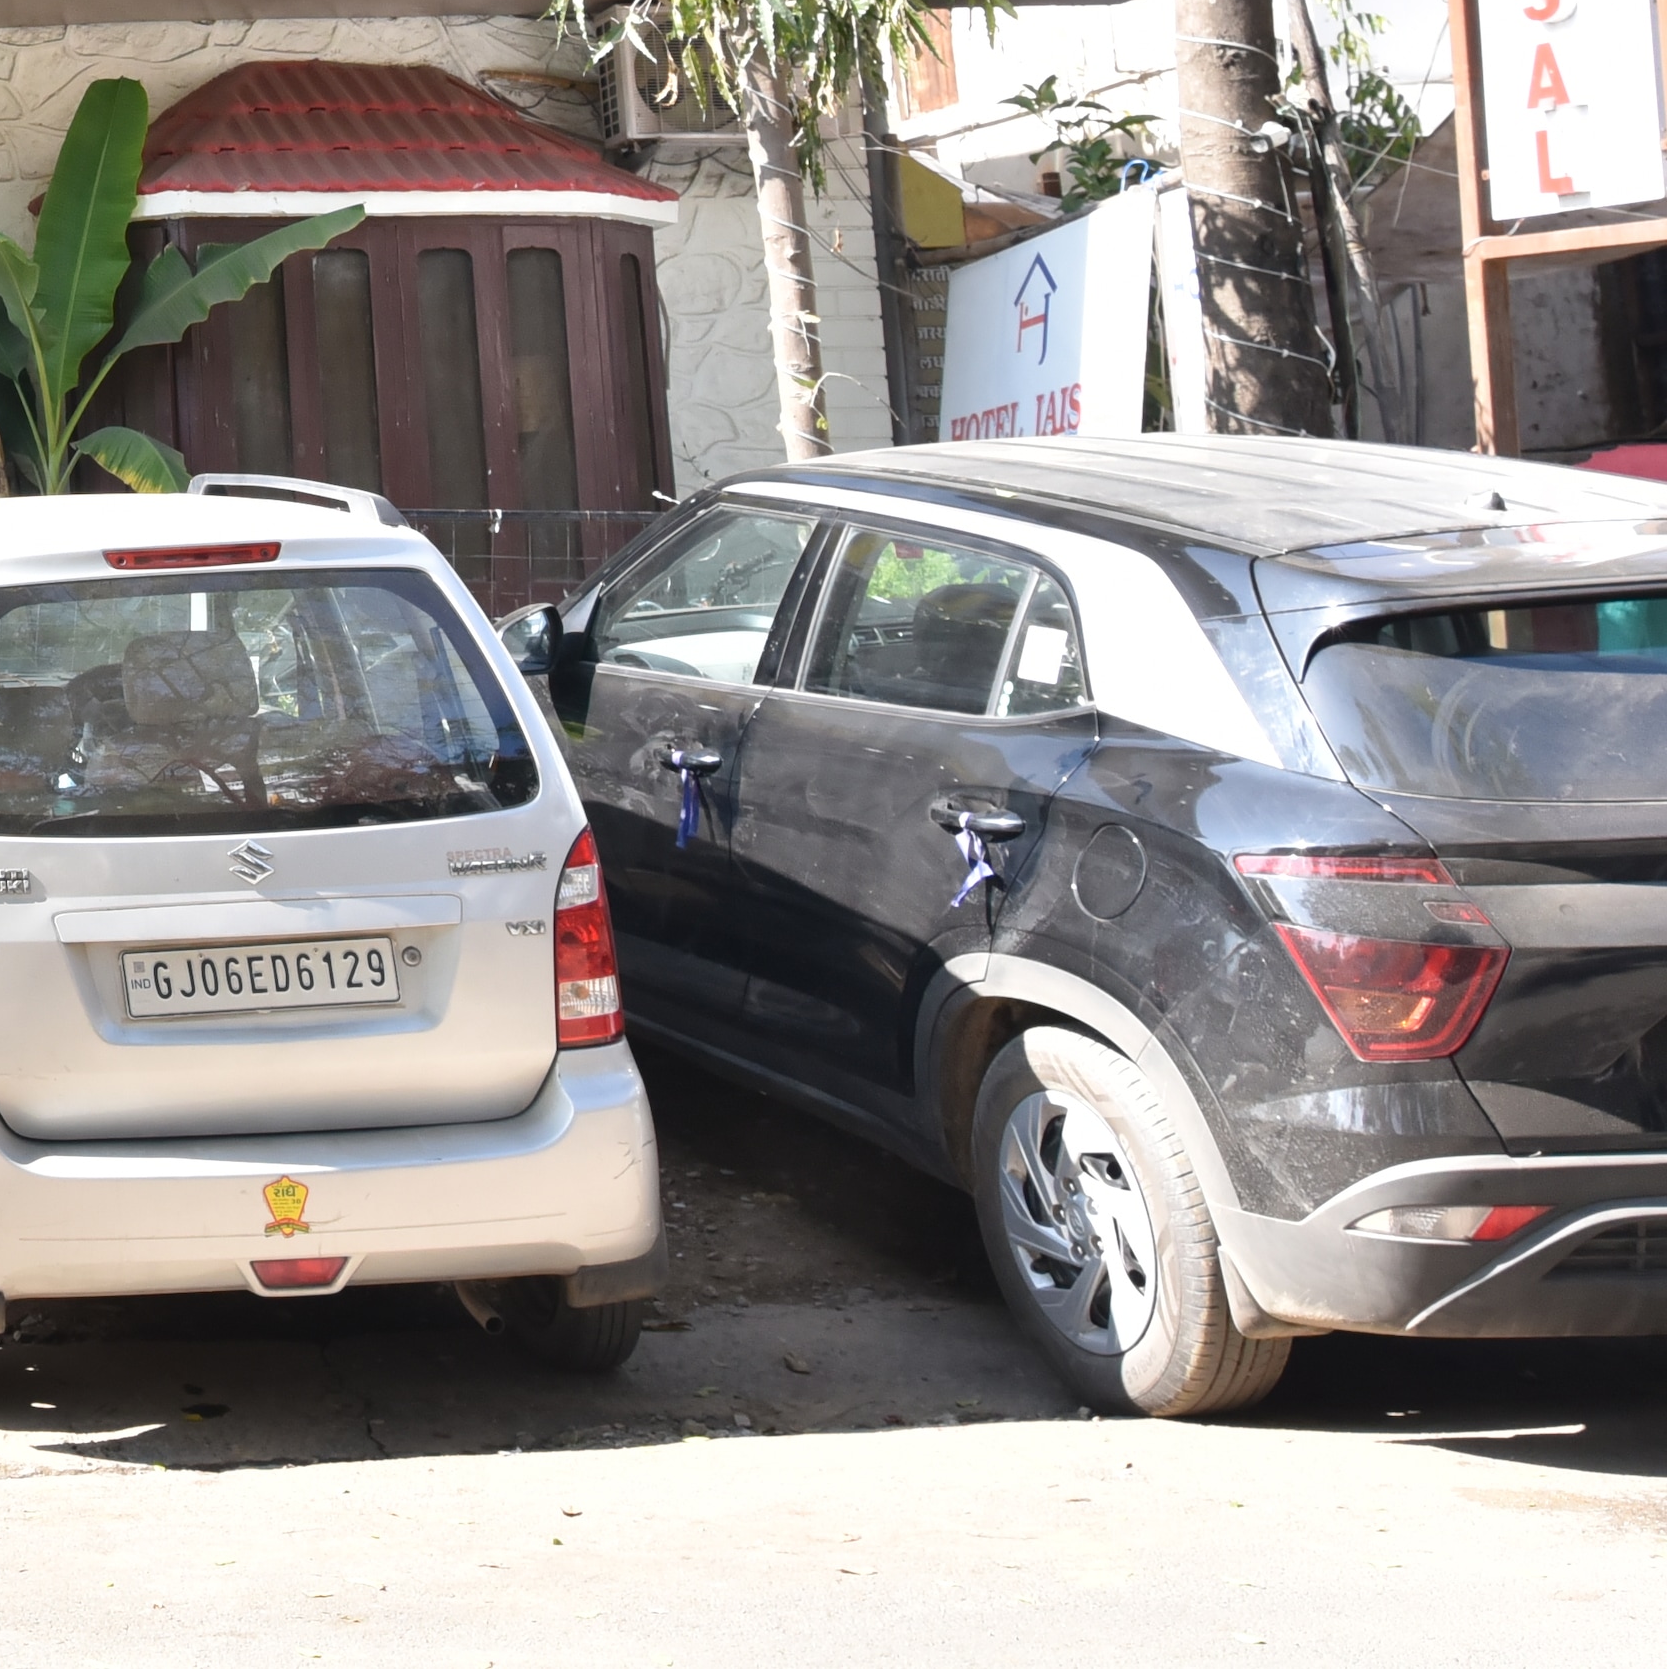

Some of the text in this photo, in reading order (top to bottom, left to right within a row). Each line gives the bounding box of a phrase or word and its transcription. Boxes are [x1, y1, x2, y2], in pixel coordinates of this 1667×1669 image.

[446, 847, 513, 863] SPECTRA
[130, 948, 386, 1000] IND GJ06ED6129
